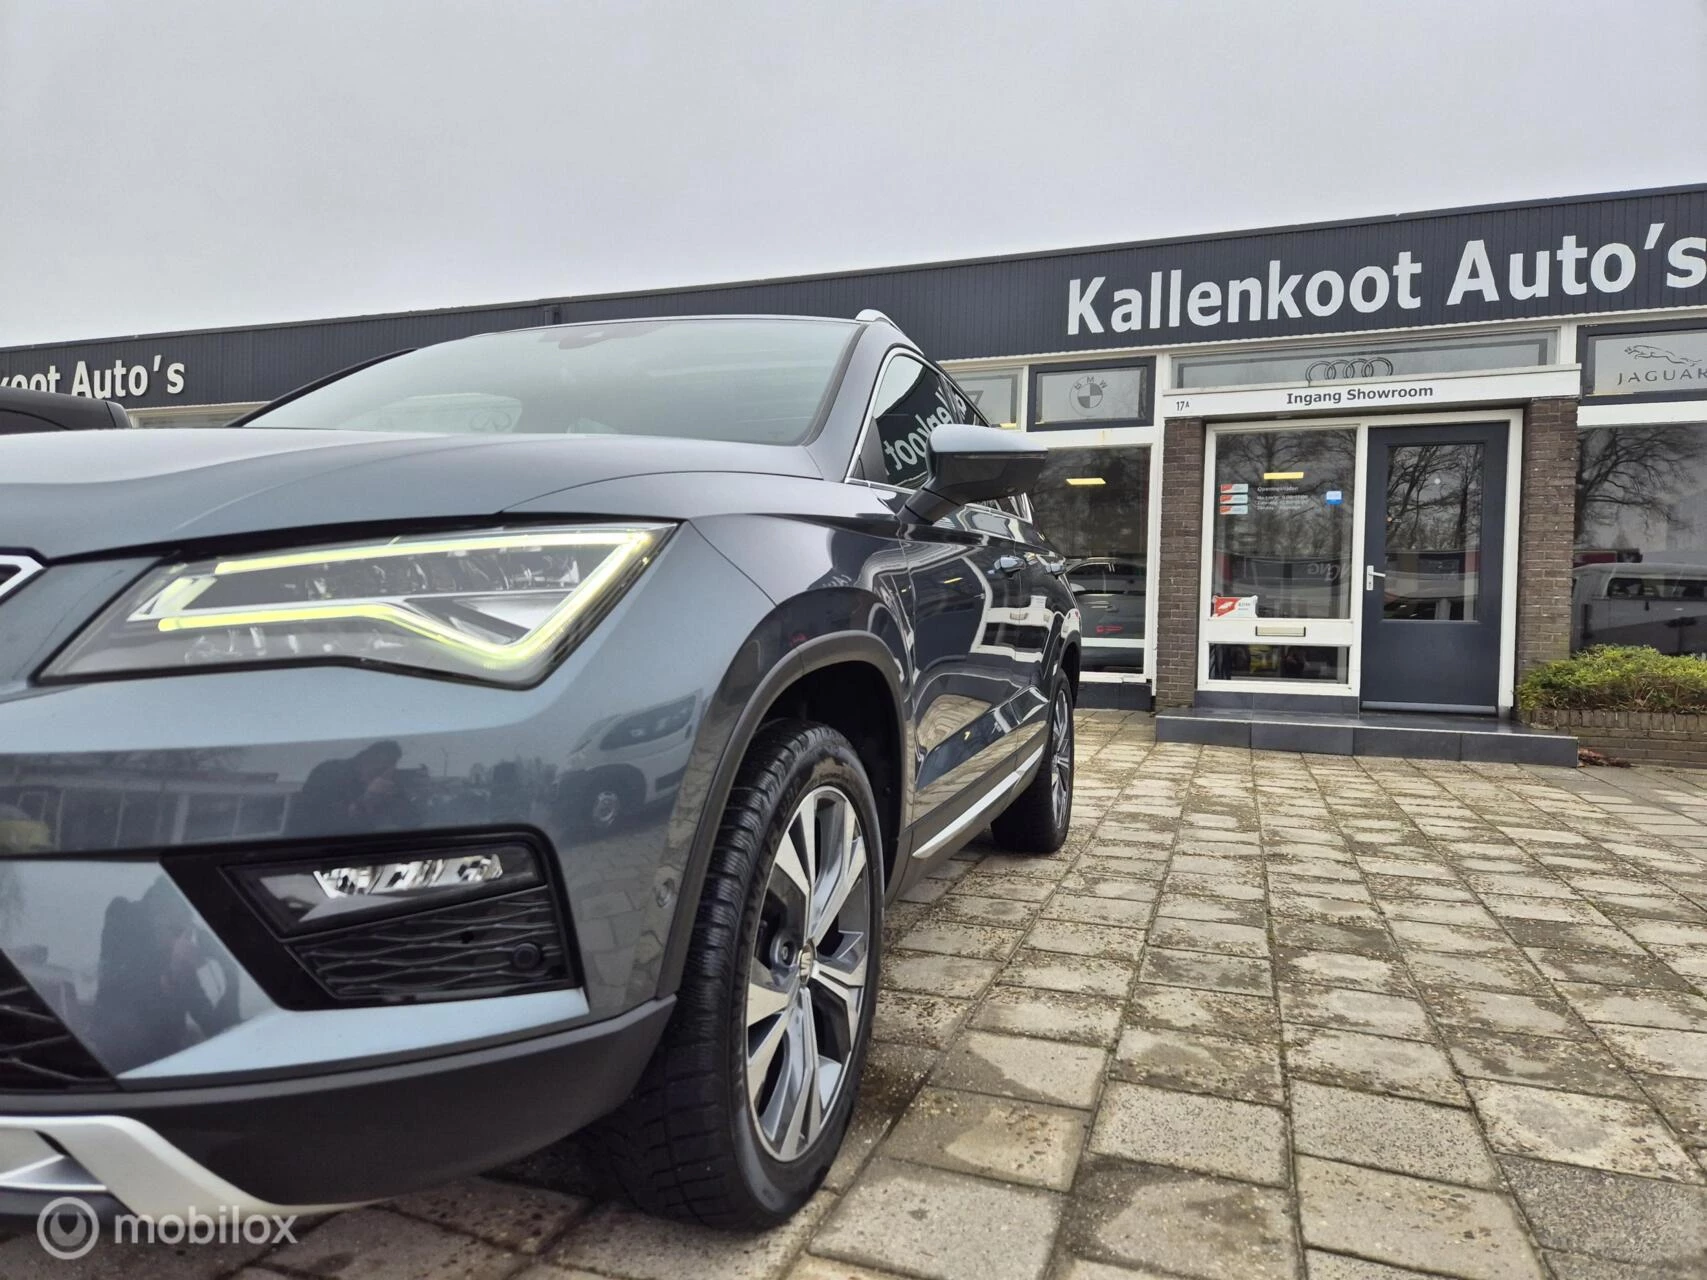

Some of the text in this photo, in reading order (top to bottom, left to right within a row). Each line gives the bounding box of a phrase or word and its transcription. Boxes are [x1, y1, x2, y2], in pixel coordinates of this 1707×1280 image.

[1067, 223, 1707, 336] Kallenkoot Auto's
[71, 355, 185, 399] Auto's
[1175, 400, 1190, 412] 17A
[1286, 386, 1434, 406] Ingang Showroom
